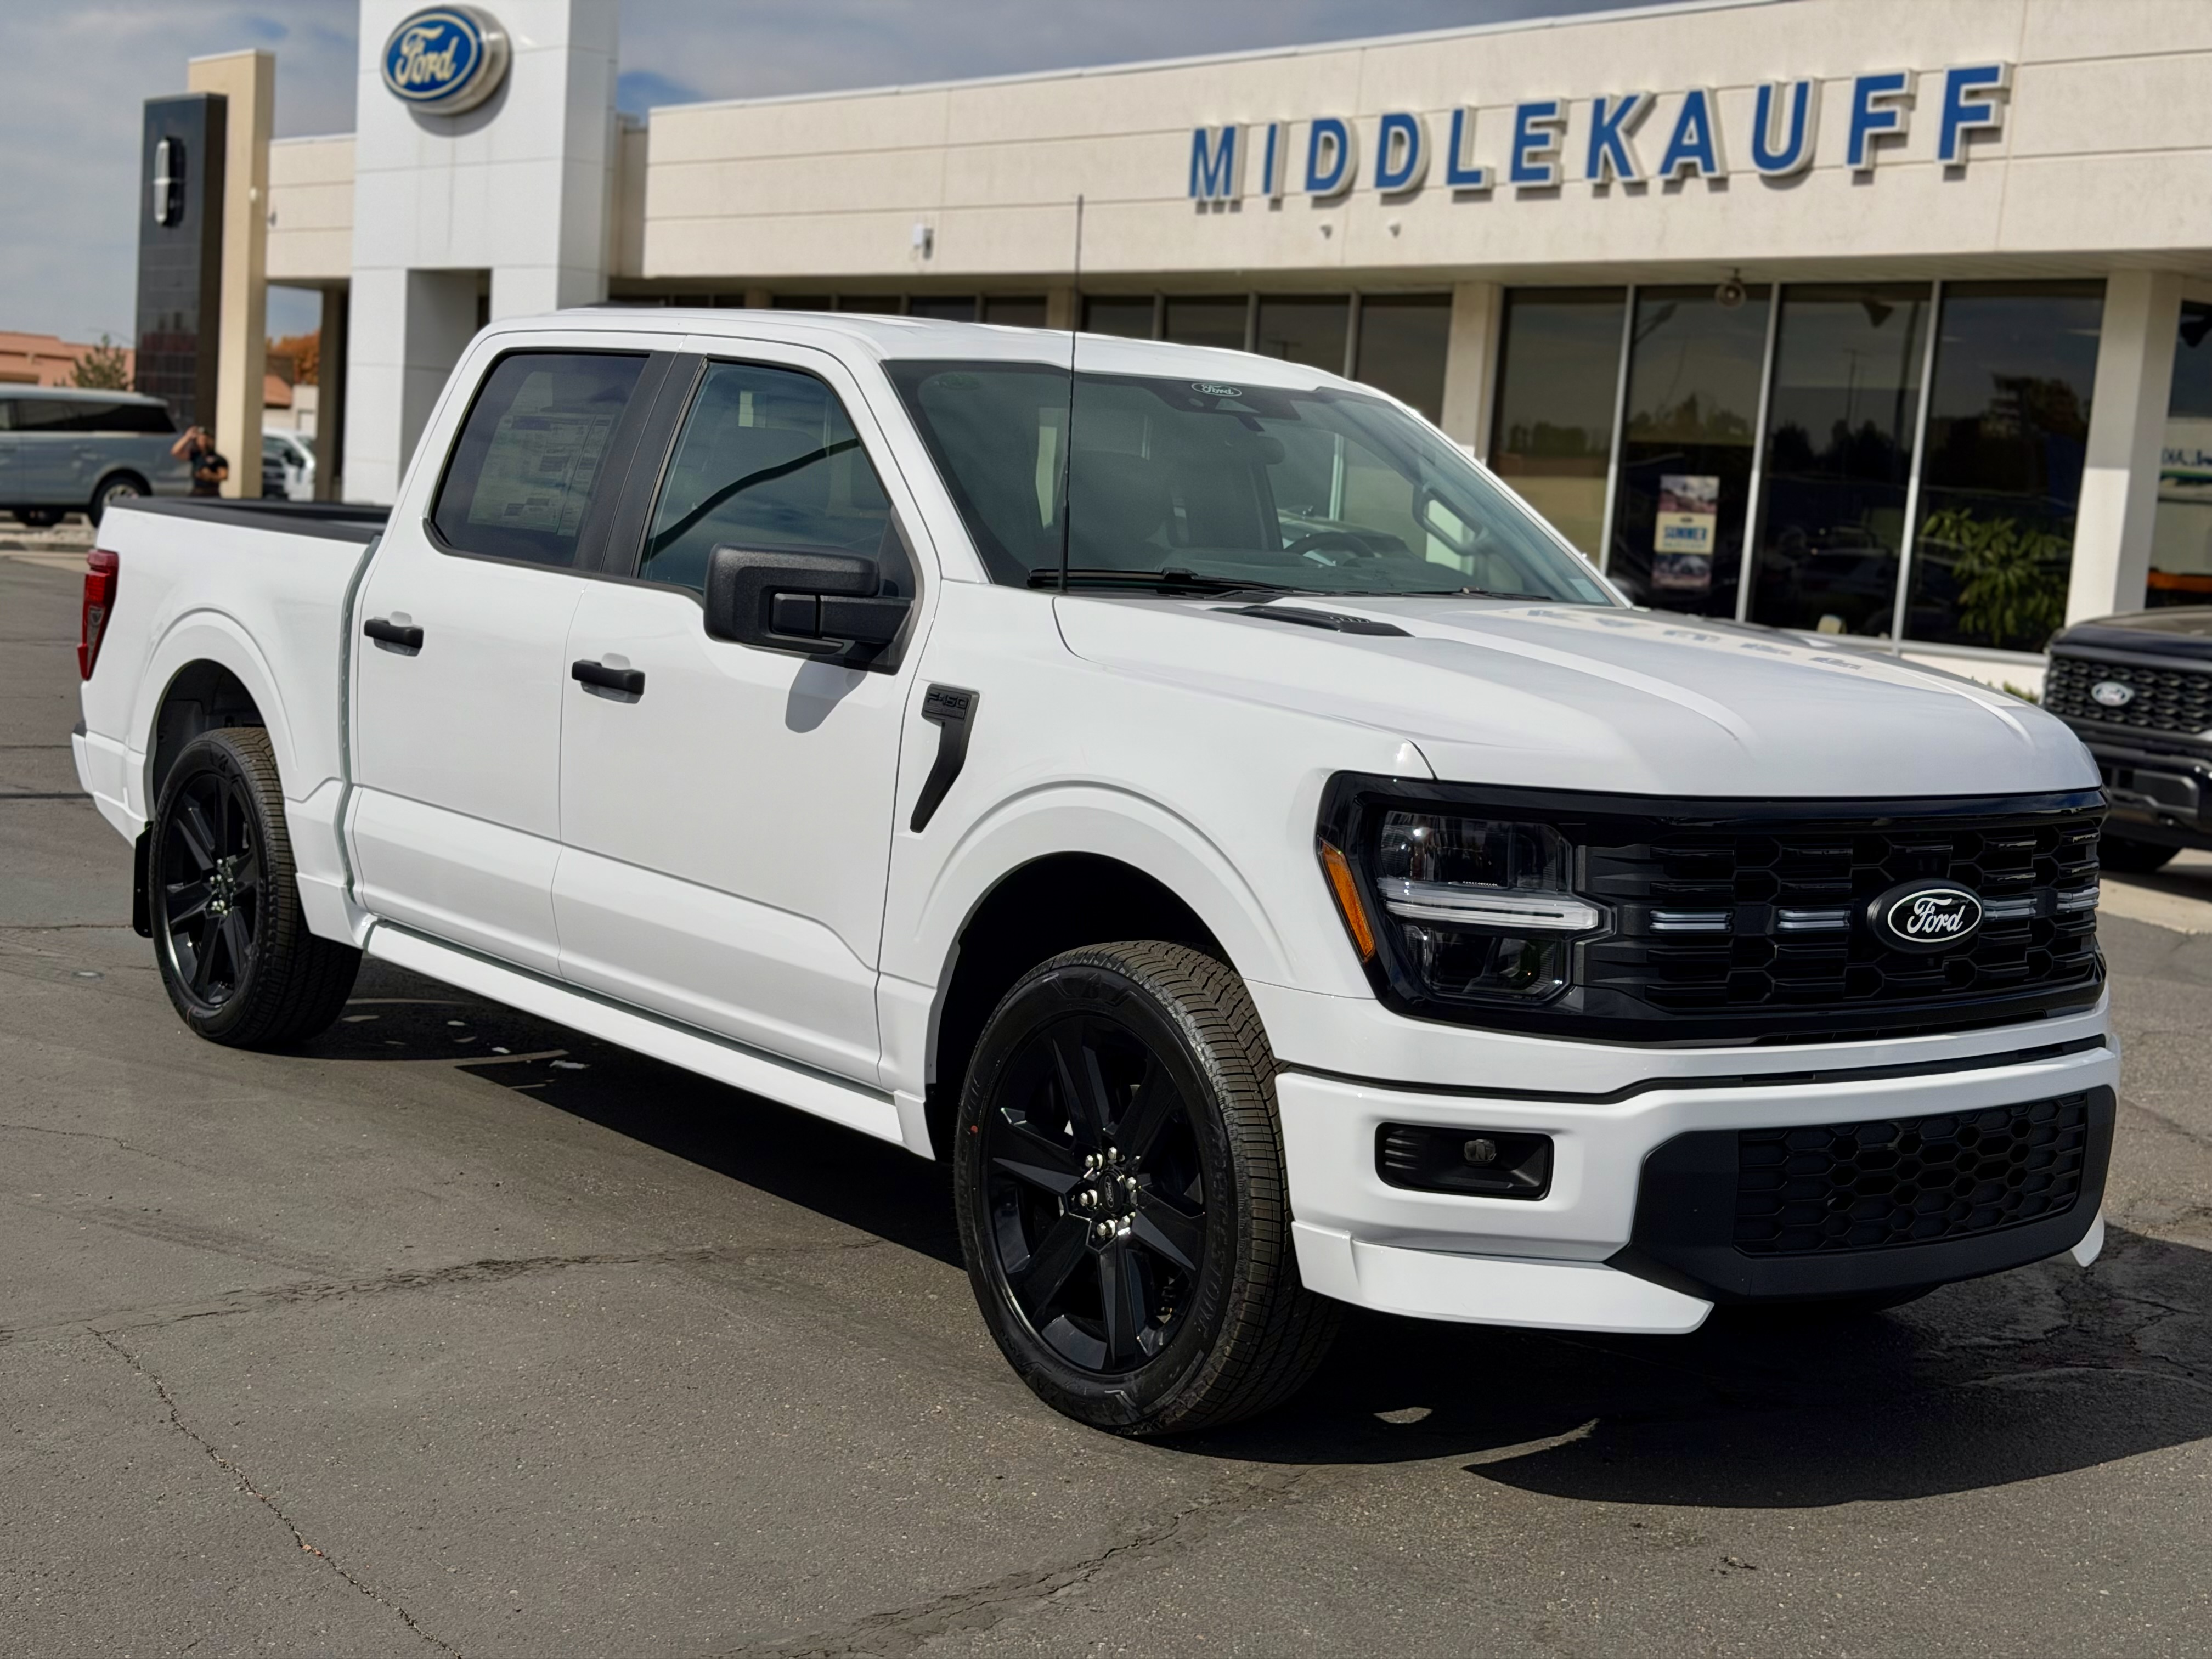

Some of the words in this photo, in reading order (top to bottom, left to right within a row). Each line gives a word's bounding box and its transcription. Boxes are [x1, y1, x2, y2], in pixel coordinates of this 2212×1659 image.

[394, 26, 459, 86] Ford
[1188, 63, 2006, 201] MIDDLEKAUFF
[1201, 384, 1234, 395] Ford
[926, 692, 969, 709] F-150
[1906, 897, 1966, 934] Ford
